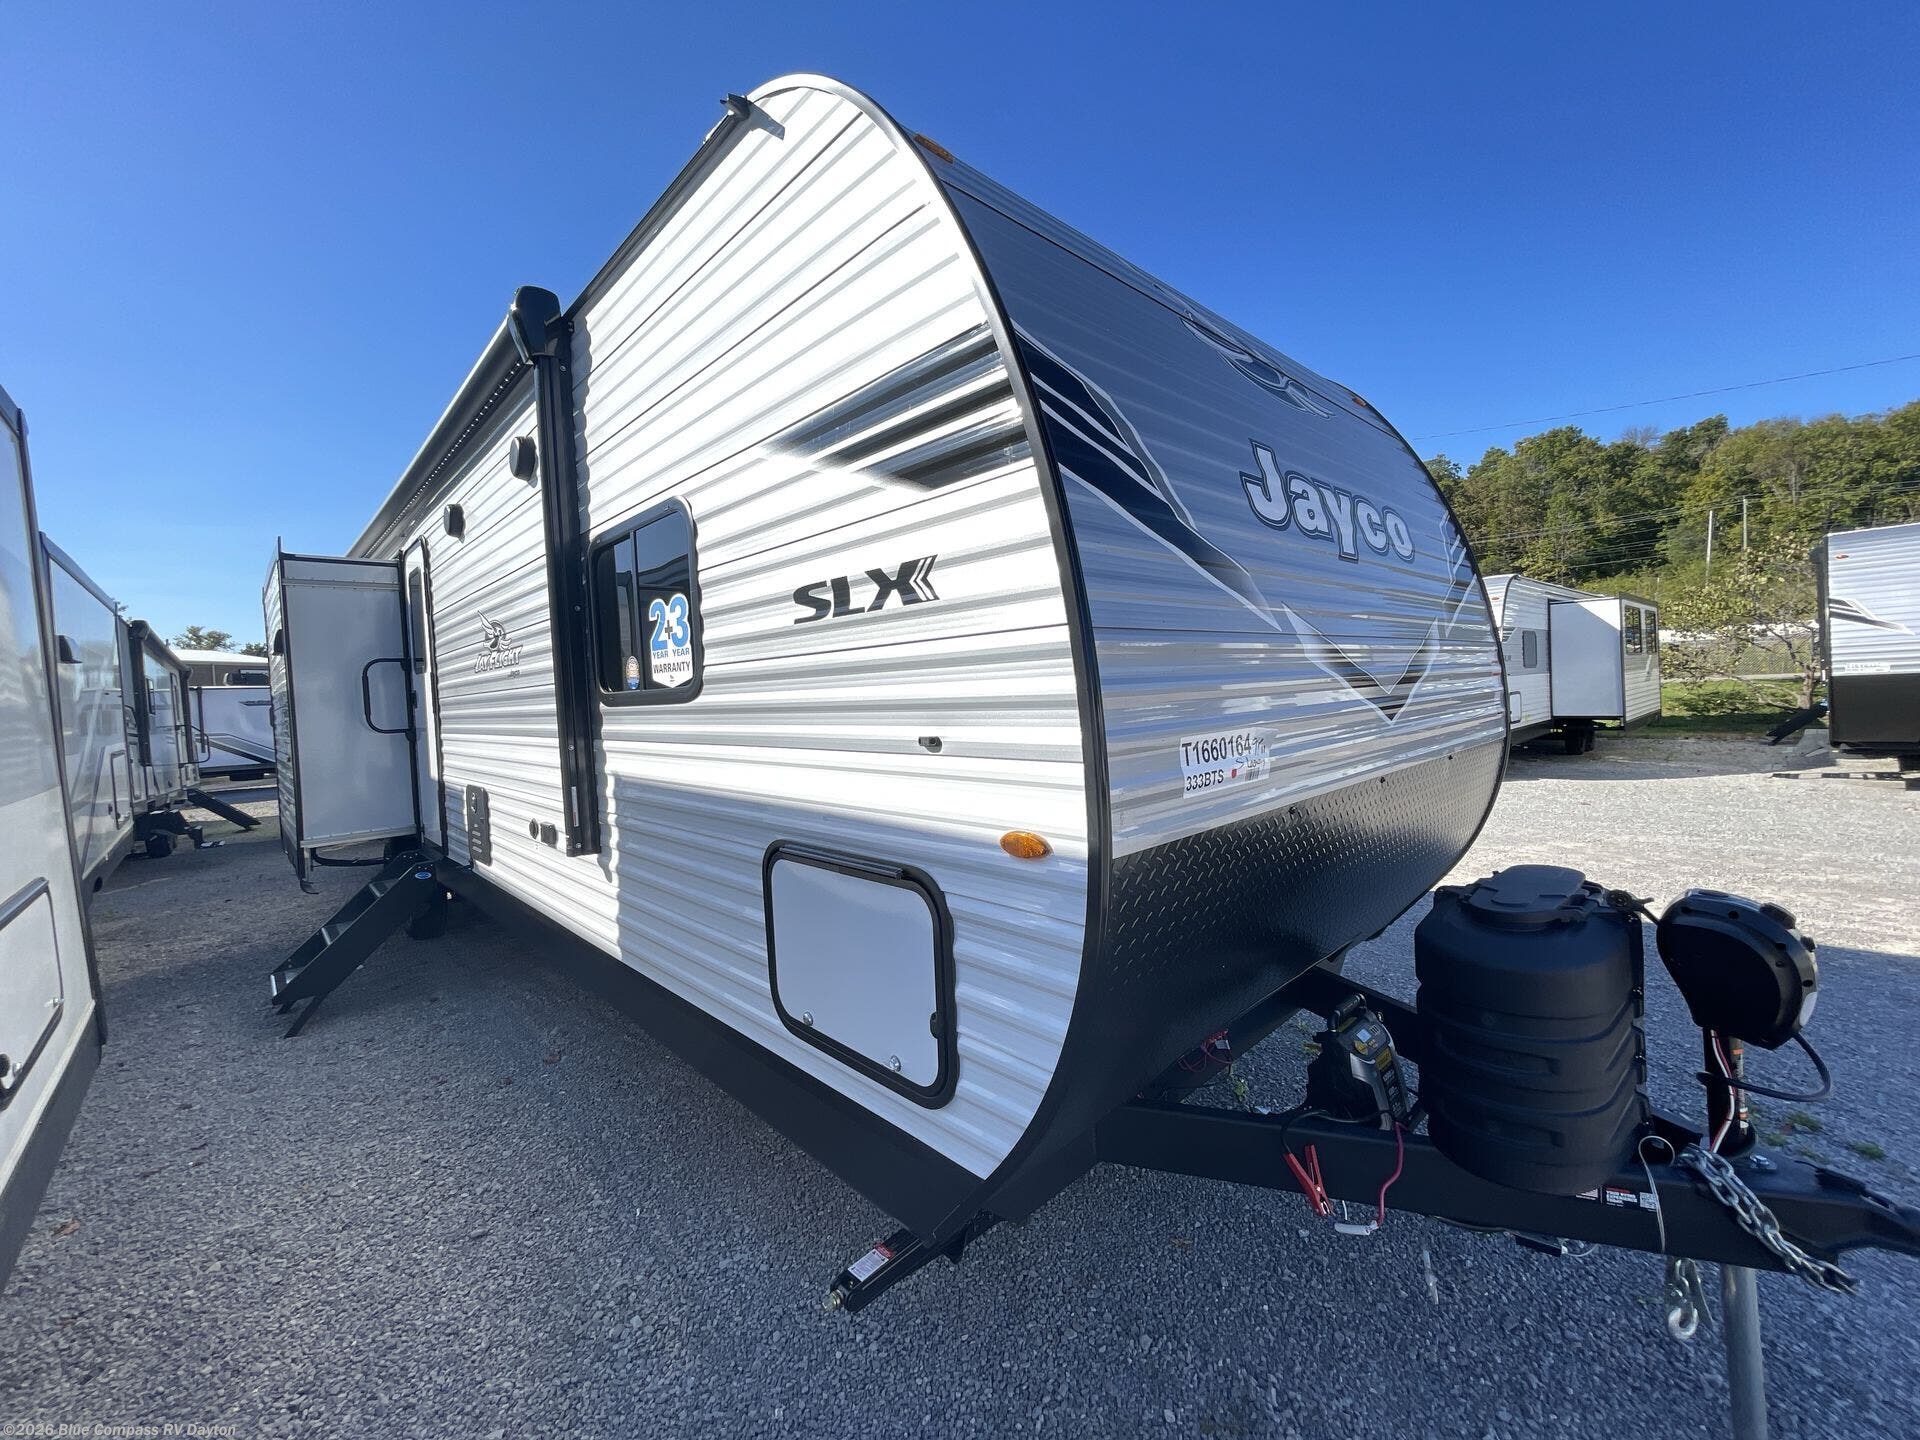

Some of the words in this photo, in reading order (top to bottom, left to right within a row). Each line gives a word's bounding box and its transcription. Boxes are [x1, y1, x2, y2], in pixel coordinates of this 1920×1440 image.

[1239, 438, 1415, 564] Jayco
[793, 554, 940, 625] SLX
[652, 651, 669, 659] YEAR
[672, 648, 690, 656] YEAR
[653, 661, 691, 674] WARRANTY
[1186, 769, 1224, 792] 333BTS
